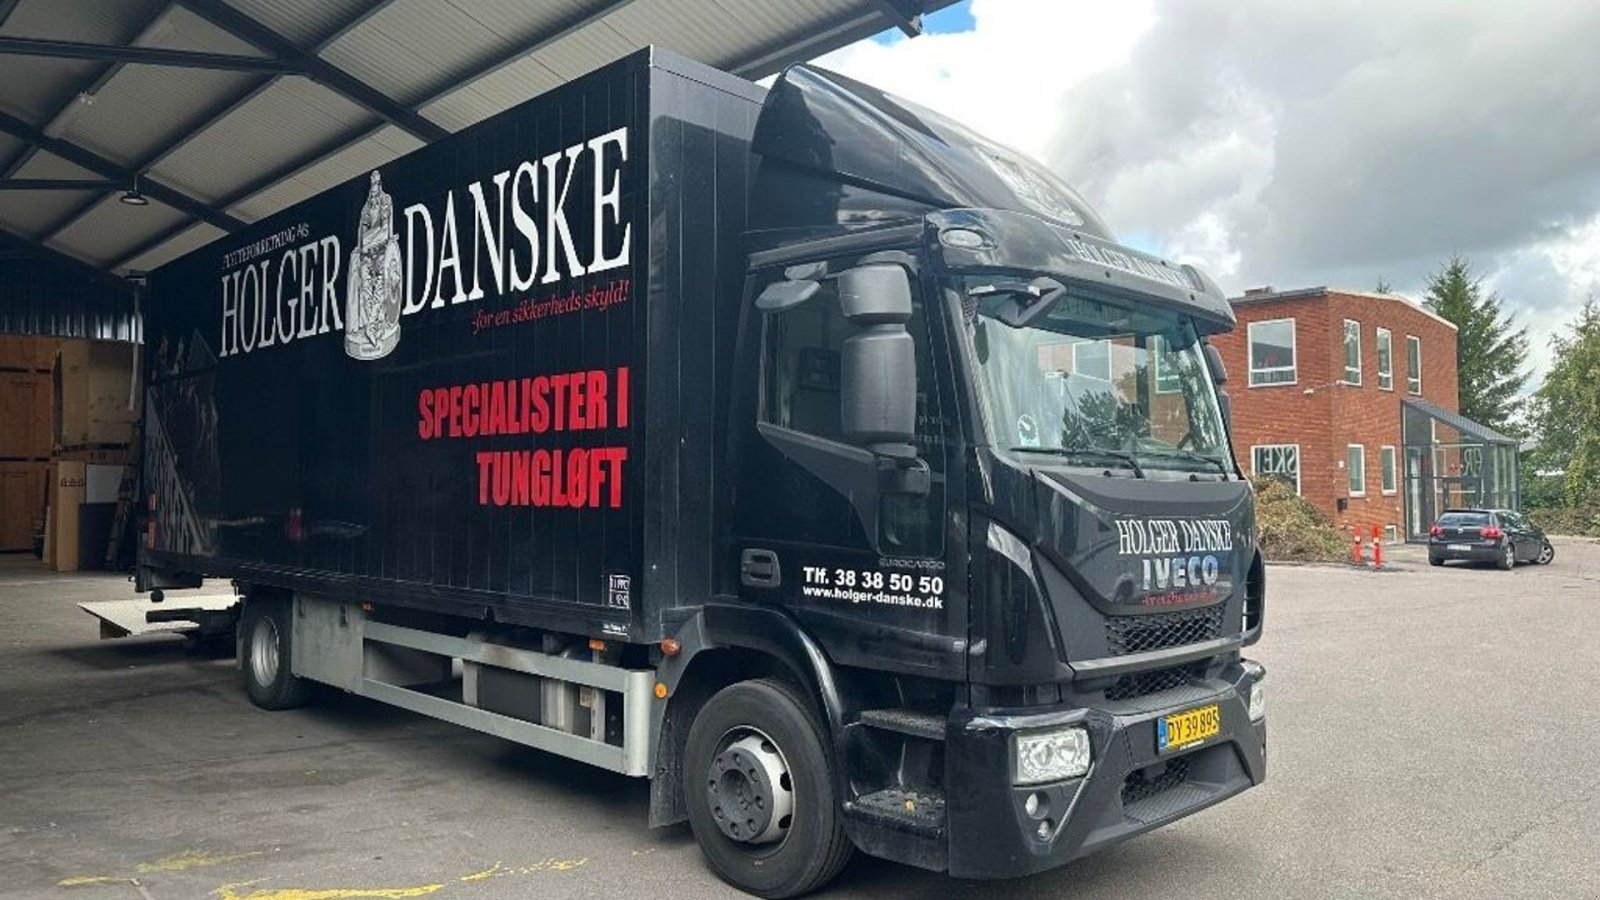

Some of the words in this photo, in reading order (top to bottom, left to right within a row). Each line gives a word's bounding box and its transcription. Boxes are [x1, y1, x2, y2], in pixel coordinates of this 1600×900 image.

[218, 234, 344, 358] HOLGER
[402, 127, 631, 315] DANSKE
[494, 309, 510, 326] en
[512, 290, 581, 324] sikkerheds
[584, 279, 630, 313] skyld!
[418, 370, 608, 440] SPECIALISTER
[617, 367, 629, 428] I
[476, 447, 628, 508] TUNGLØFT
[1115, 519, 1180, 555] HOLGER
[1179, 519, 1233, 552] DANSKE
[803, 566, 829, 584] Tlf.
[834, 568, 856, 587] 38
[861, 571, 884, 589] 38
[889, 573, 913, 592] 50
[918, 576, 944, 595] 50
[1142, 555, 1218, 590] IVECO
[803, 585, 944, 609] www.holger-danske.dk
